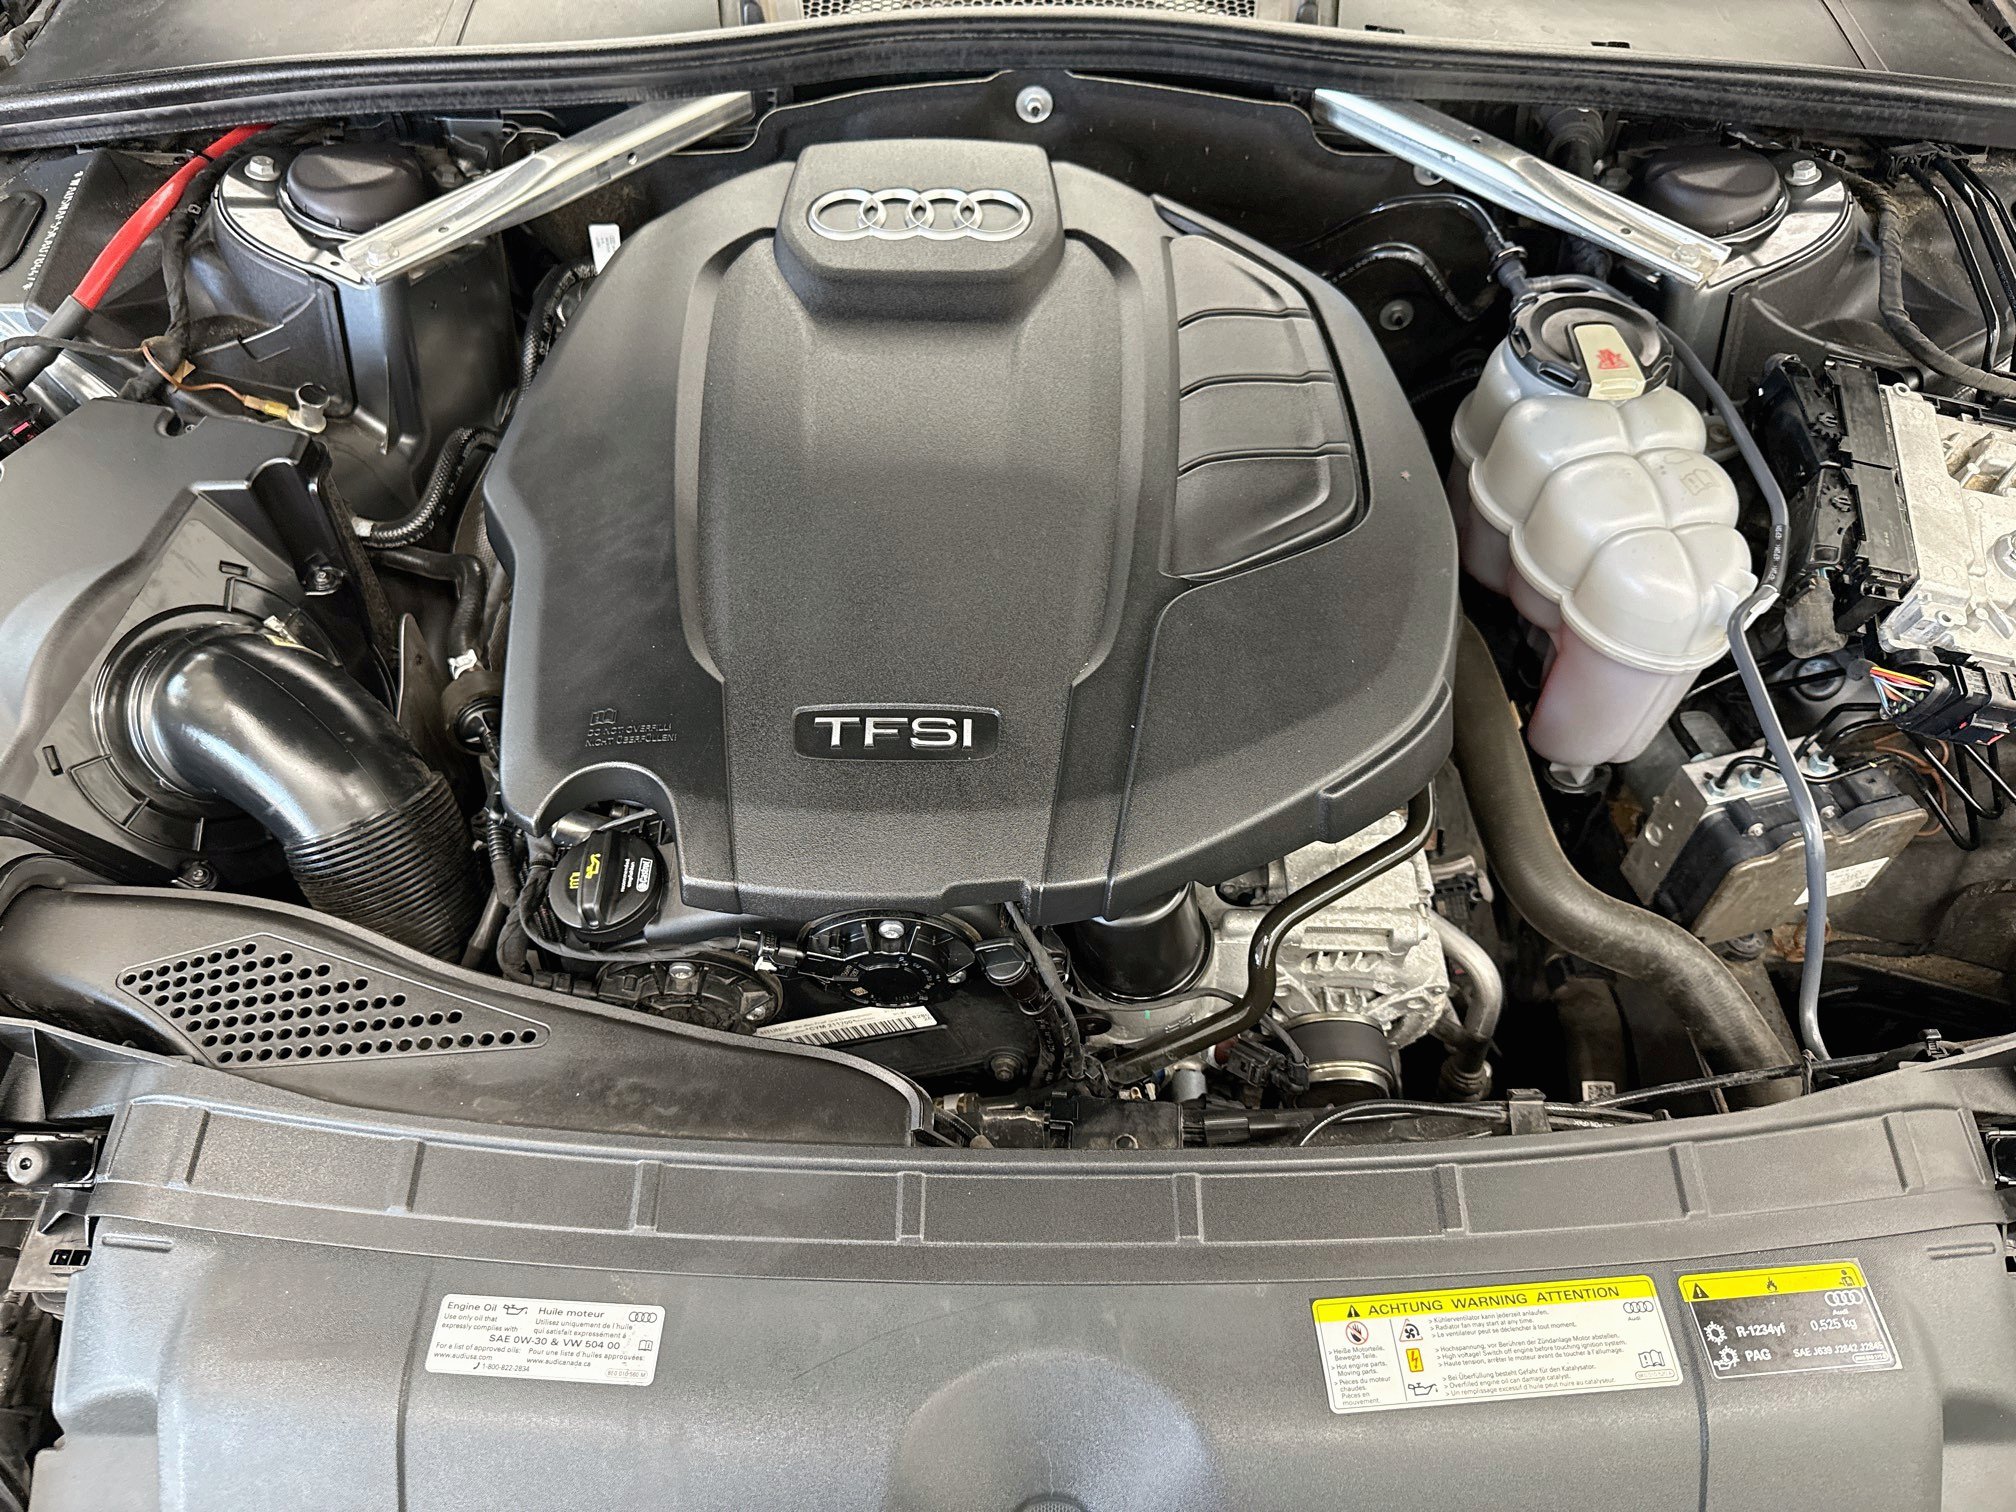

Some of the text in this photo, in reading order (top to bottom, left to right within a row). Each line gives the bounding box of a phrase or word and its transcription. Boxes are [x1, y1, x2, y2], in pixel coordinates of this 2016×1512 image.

[813, 717, 973, 750] TFSI
[1368, 1286, 1620, 1316] ACHTUNG WARNING ATTENTION
[446, 1301, 497, 1312] Engine Oil
[538, 1307, 604, 1318] Huile moteur
[1496, 1310, 1521, 1319] jederzeit
[1832, 1308, 1849, 1316] Audi
[457, 1314, 473, 1322] only
[441, 1322, 472, 1330] expressly
[473, 1324, 502, 1332] complies
[560, 1320, 600, 1329] uniquement
[1810, 1317, 1858, 1332] 0,525 kg
[1735, 1322, 1787, 1338] R-1234yf
[488, 1334, 620, 1349] SAE 0W-30 & VW 504 00
[1537, 1336, 1571, 1345] Zündanlage
[473, 1344, 505, 1353] approved
[1554, 1343, 1580, 1351] touching
[1580, 1341, 1603, 1349] ignition
[1744, 1348, 1772, 1362] PAG
[1792, 1347, 1812, 1358] SAE
[1812, 1346, 1832, 1356] J639
[1334, 1354, 1360, 1362] Bewegte
[1348, 1362, 1369, 1370] engine
[1370, 1360, 1388, 1368] parts.
[1337, 1369, 1360, 1377] Moving
[1517, 1367, 1538, 1375] Gefahr
[1449, 1380, 1478, 1388] Overfilled
[1521, 1375, 1546, 1383] damage
[1460, 1387, 1497, 1395] remplissage
[1498, 1384, 1522, 1392] excessif
